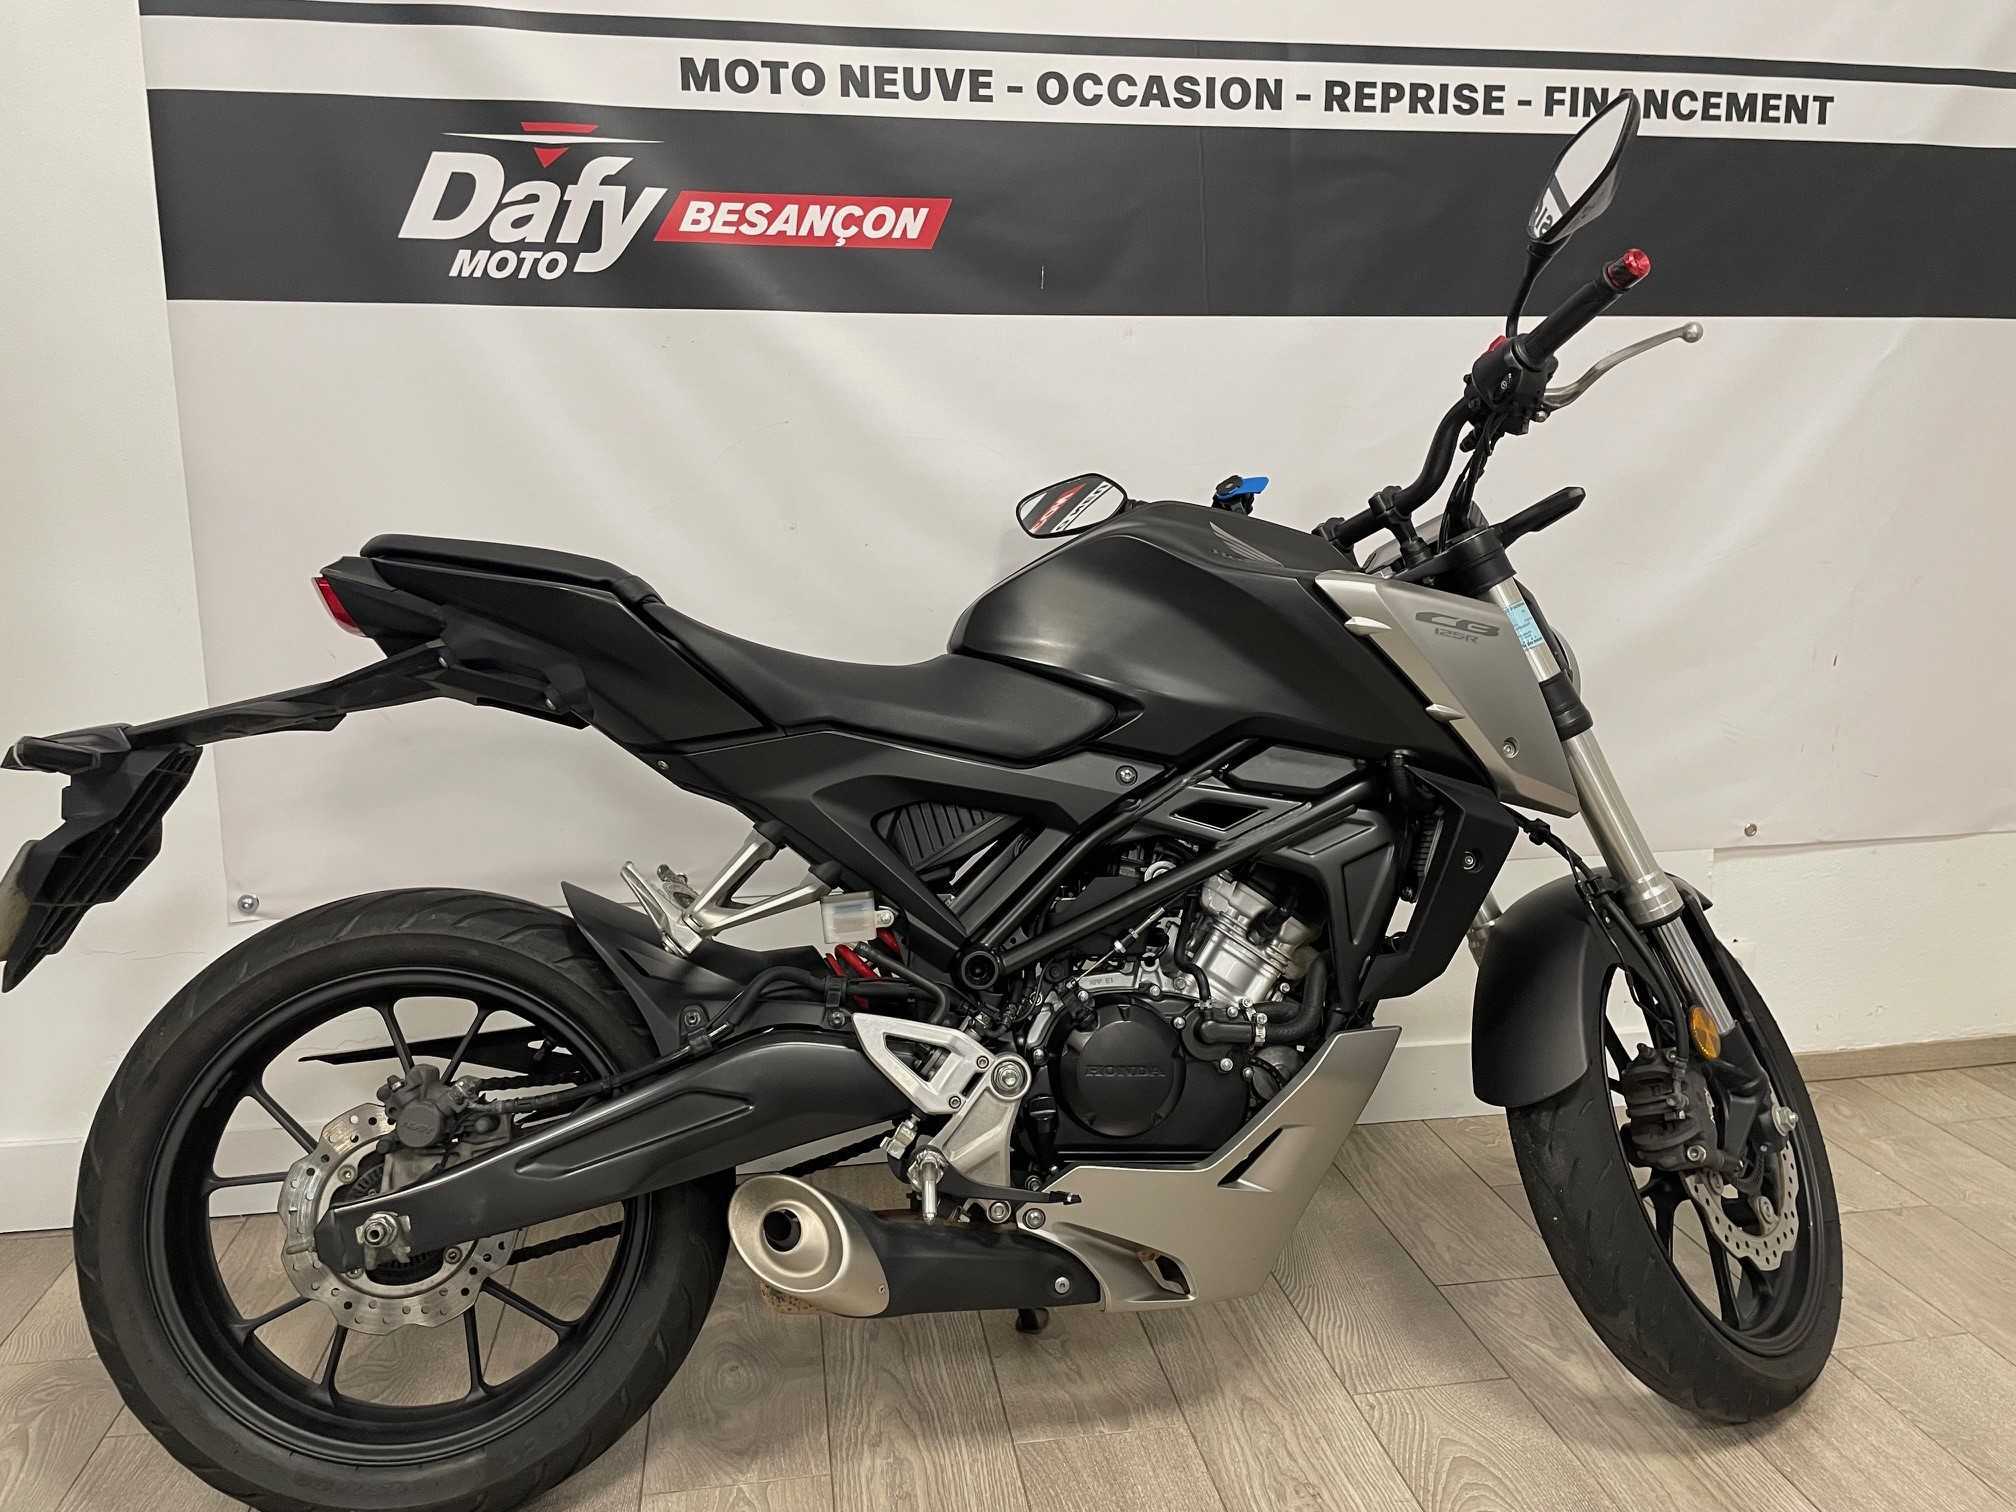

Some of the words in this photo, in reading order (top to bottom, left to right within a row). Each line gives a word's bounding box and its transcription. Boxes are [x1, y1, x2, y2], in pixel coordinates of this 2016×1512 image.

[679, 57, 826, 97] MOTO
[839, 63, 994, 103] NEUVE
[1036, 71, 1283, 112] OCCASION
[1324, 79, 1506, 116] REPRISE
[1544, 86, 1835, 125] FINNCEMENT
[397, 150, 669, 273] Dafy
[678, 200, 930, 247] BESANÇON
[448, 249, 568, 280] MOTO
